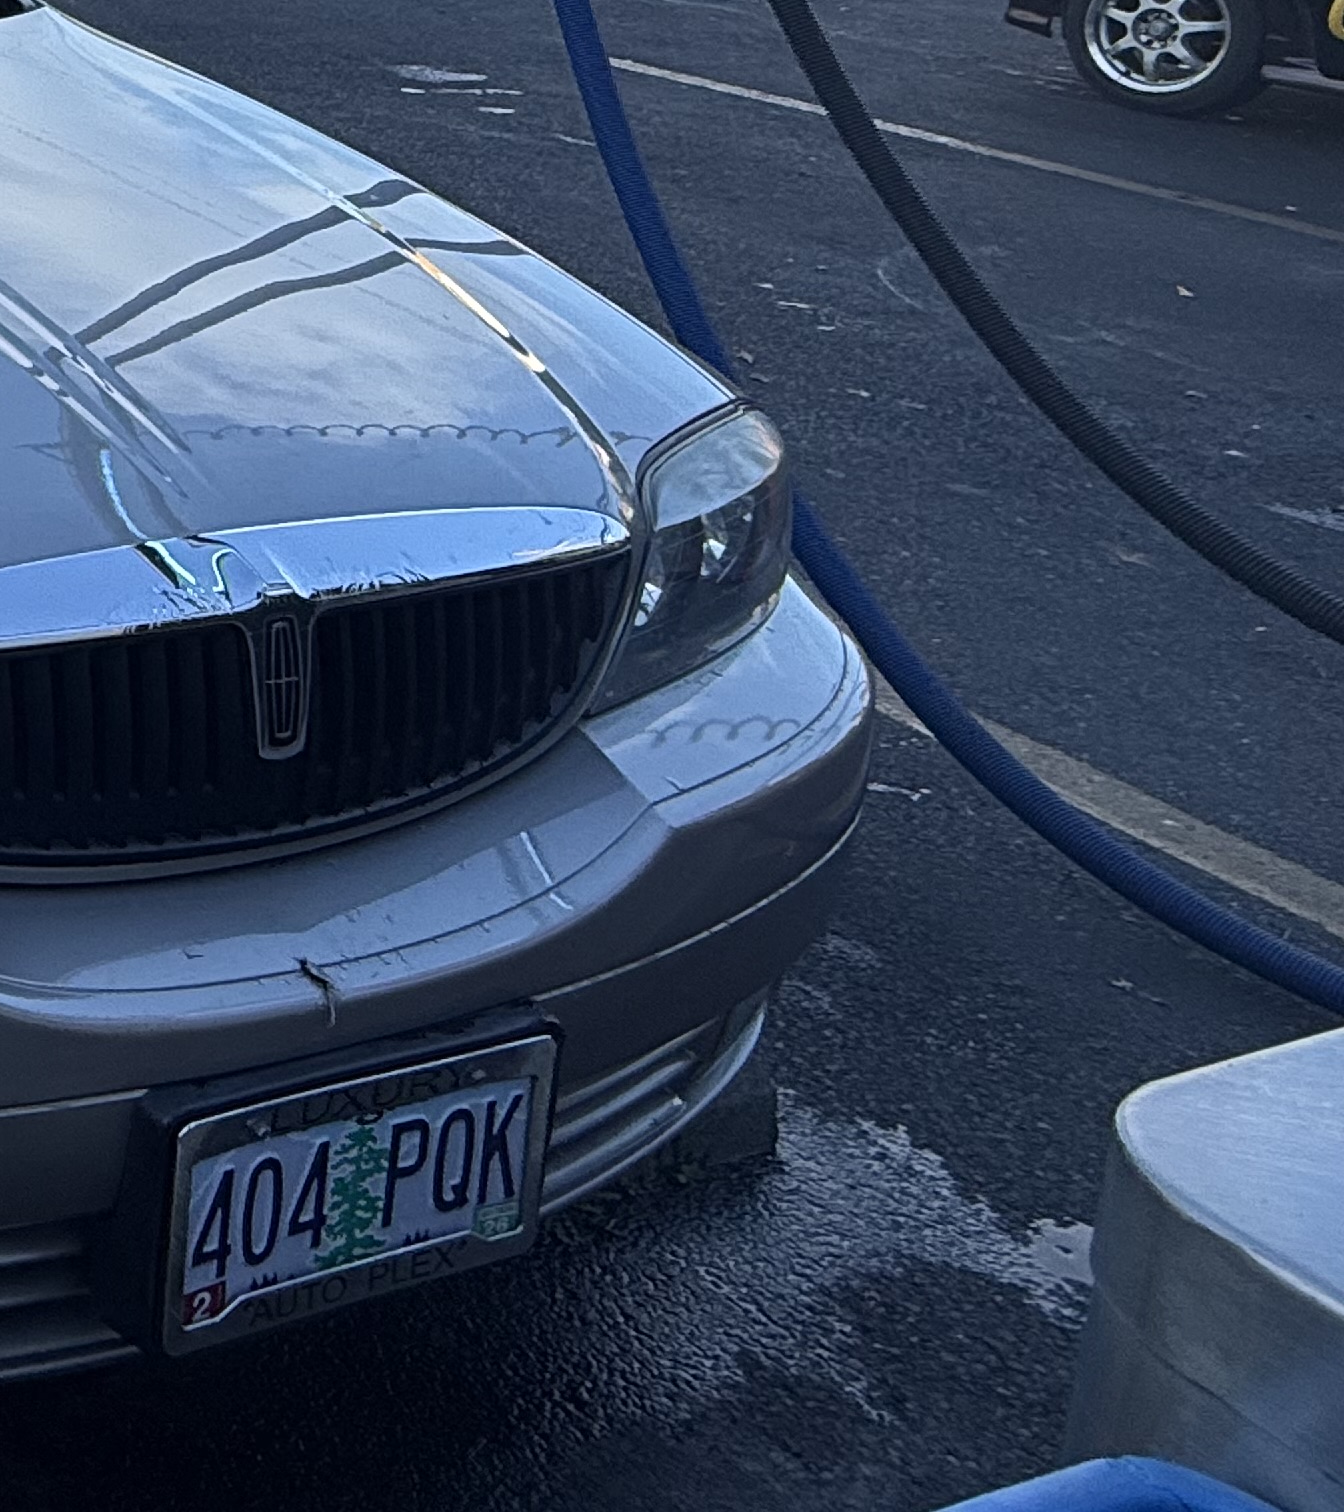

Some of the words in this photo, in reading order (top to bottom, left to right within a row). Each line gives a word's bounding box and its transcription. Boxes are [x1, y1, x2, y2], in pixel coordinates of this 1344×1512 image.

[270, 1066, 471, 1135] LUXURY
[191, 1140, 331, 1279] 404
[381, 1093, 524, 1228] PQK
[192, 1291, 211, 1322] 2
